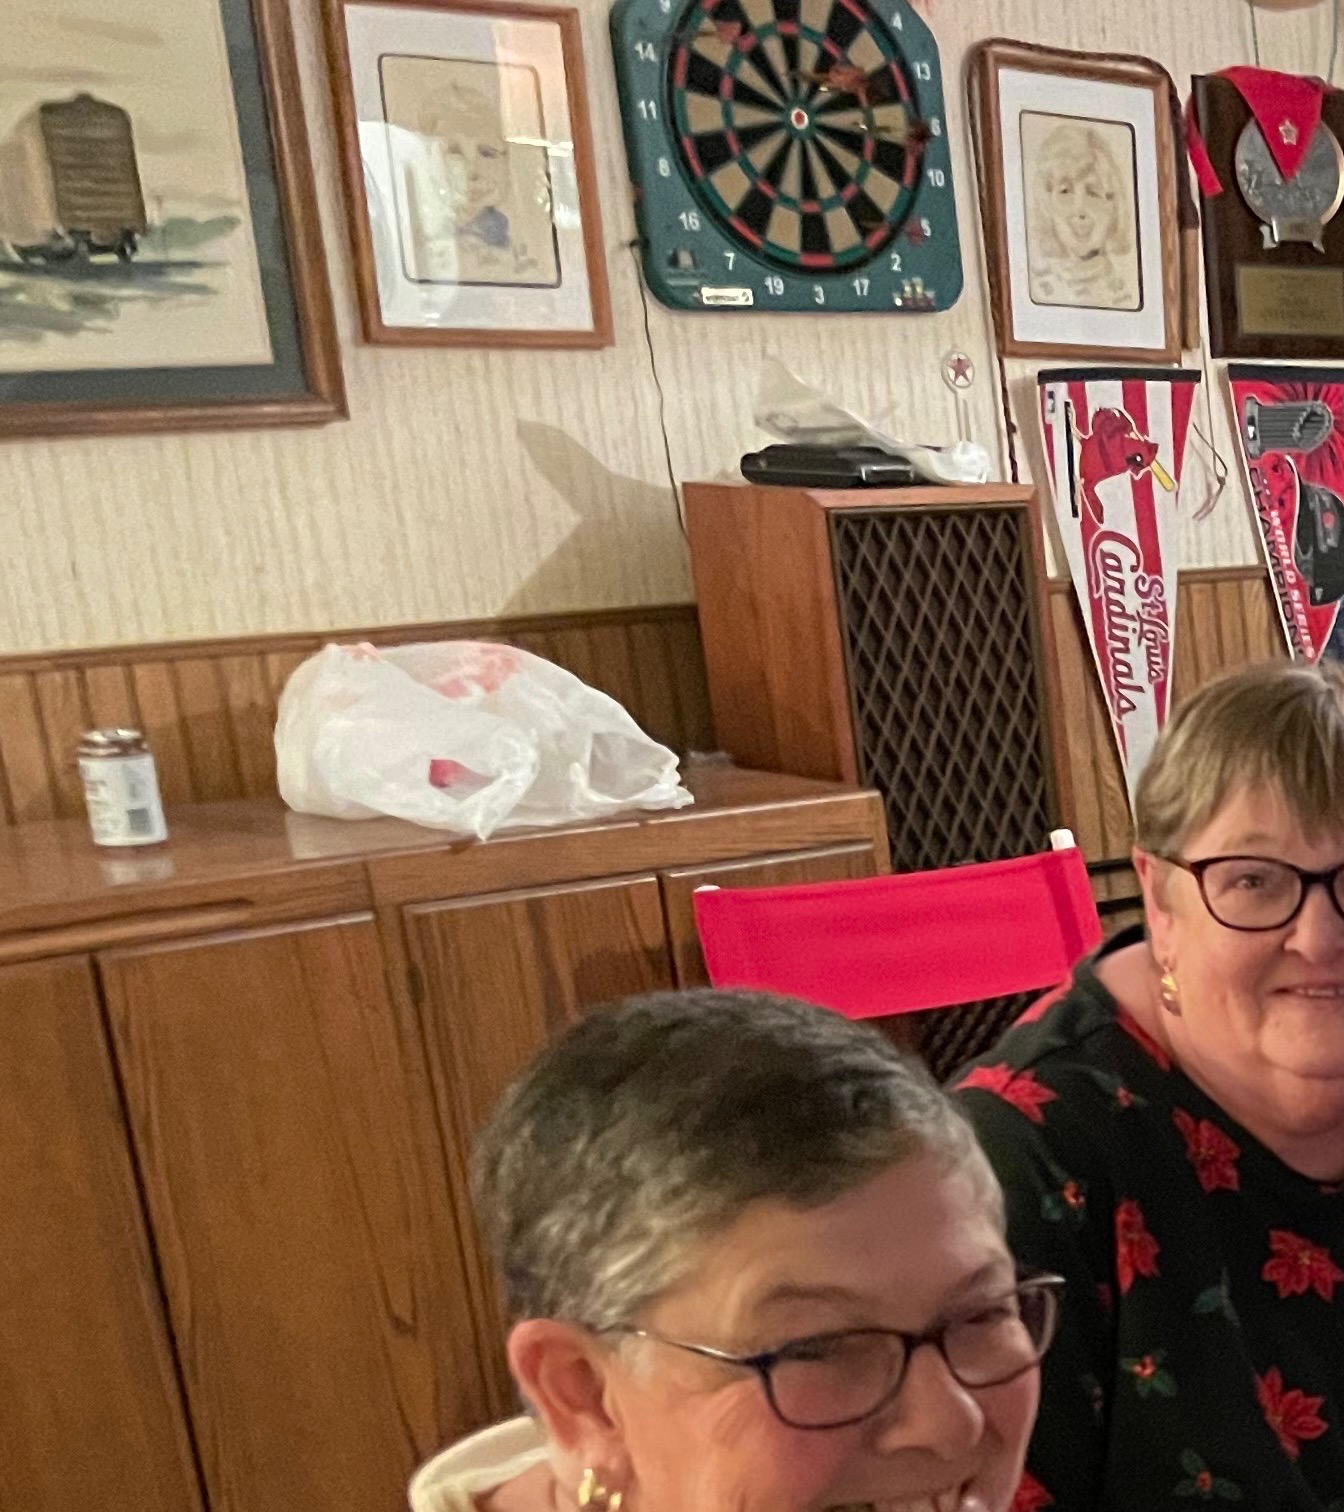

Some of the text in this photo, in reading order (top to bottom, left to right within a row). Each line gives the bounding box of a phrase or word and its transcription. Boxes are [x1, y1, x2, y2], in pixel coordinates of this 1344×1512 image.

[891, 11, 903, 31] 4
[634, 41, 658, 63] 14
[913, 61, 932, 81] 13
[638, 100, 658, 121] 11
[930, 117, 942, 137] 6
[658, 157, 672, 178] 8
[926, 168, 945, 188] 10
[677, 210, 701, 232] 16
[920, 217, 932, 237] 5
[723, 251, 736, 271] 7
[890, 252, 903, 272] 2
[764, 275, 785, 296] 19
[813, 283, 826, 306] 3
[853, 278, 870, 297] 17
[1269, 508, 1317, 660] WORLD SERIES
[1089, 529, 1146, 723] Cardinals
[1136, 610, 1169, 685] Louis
